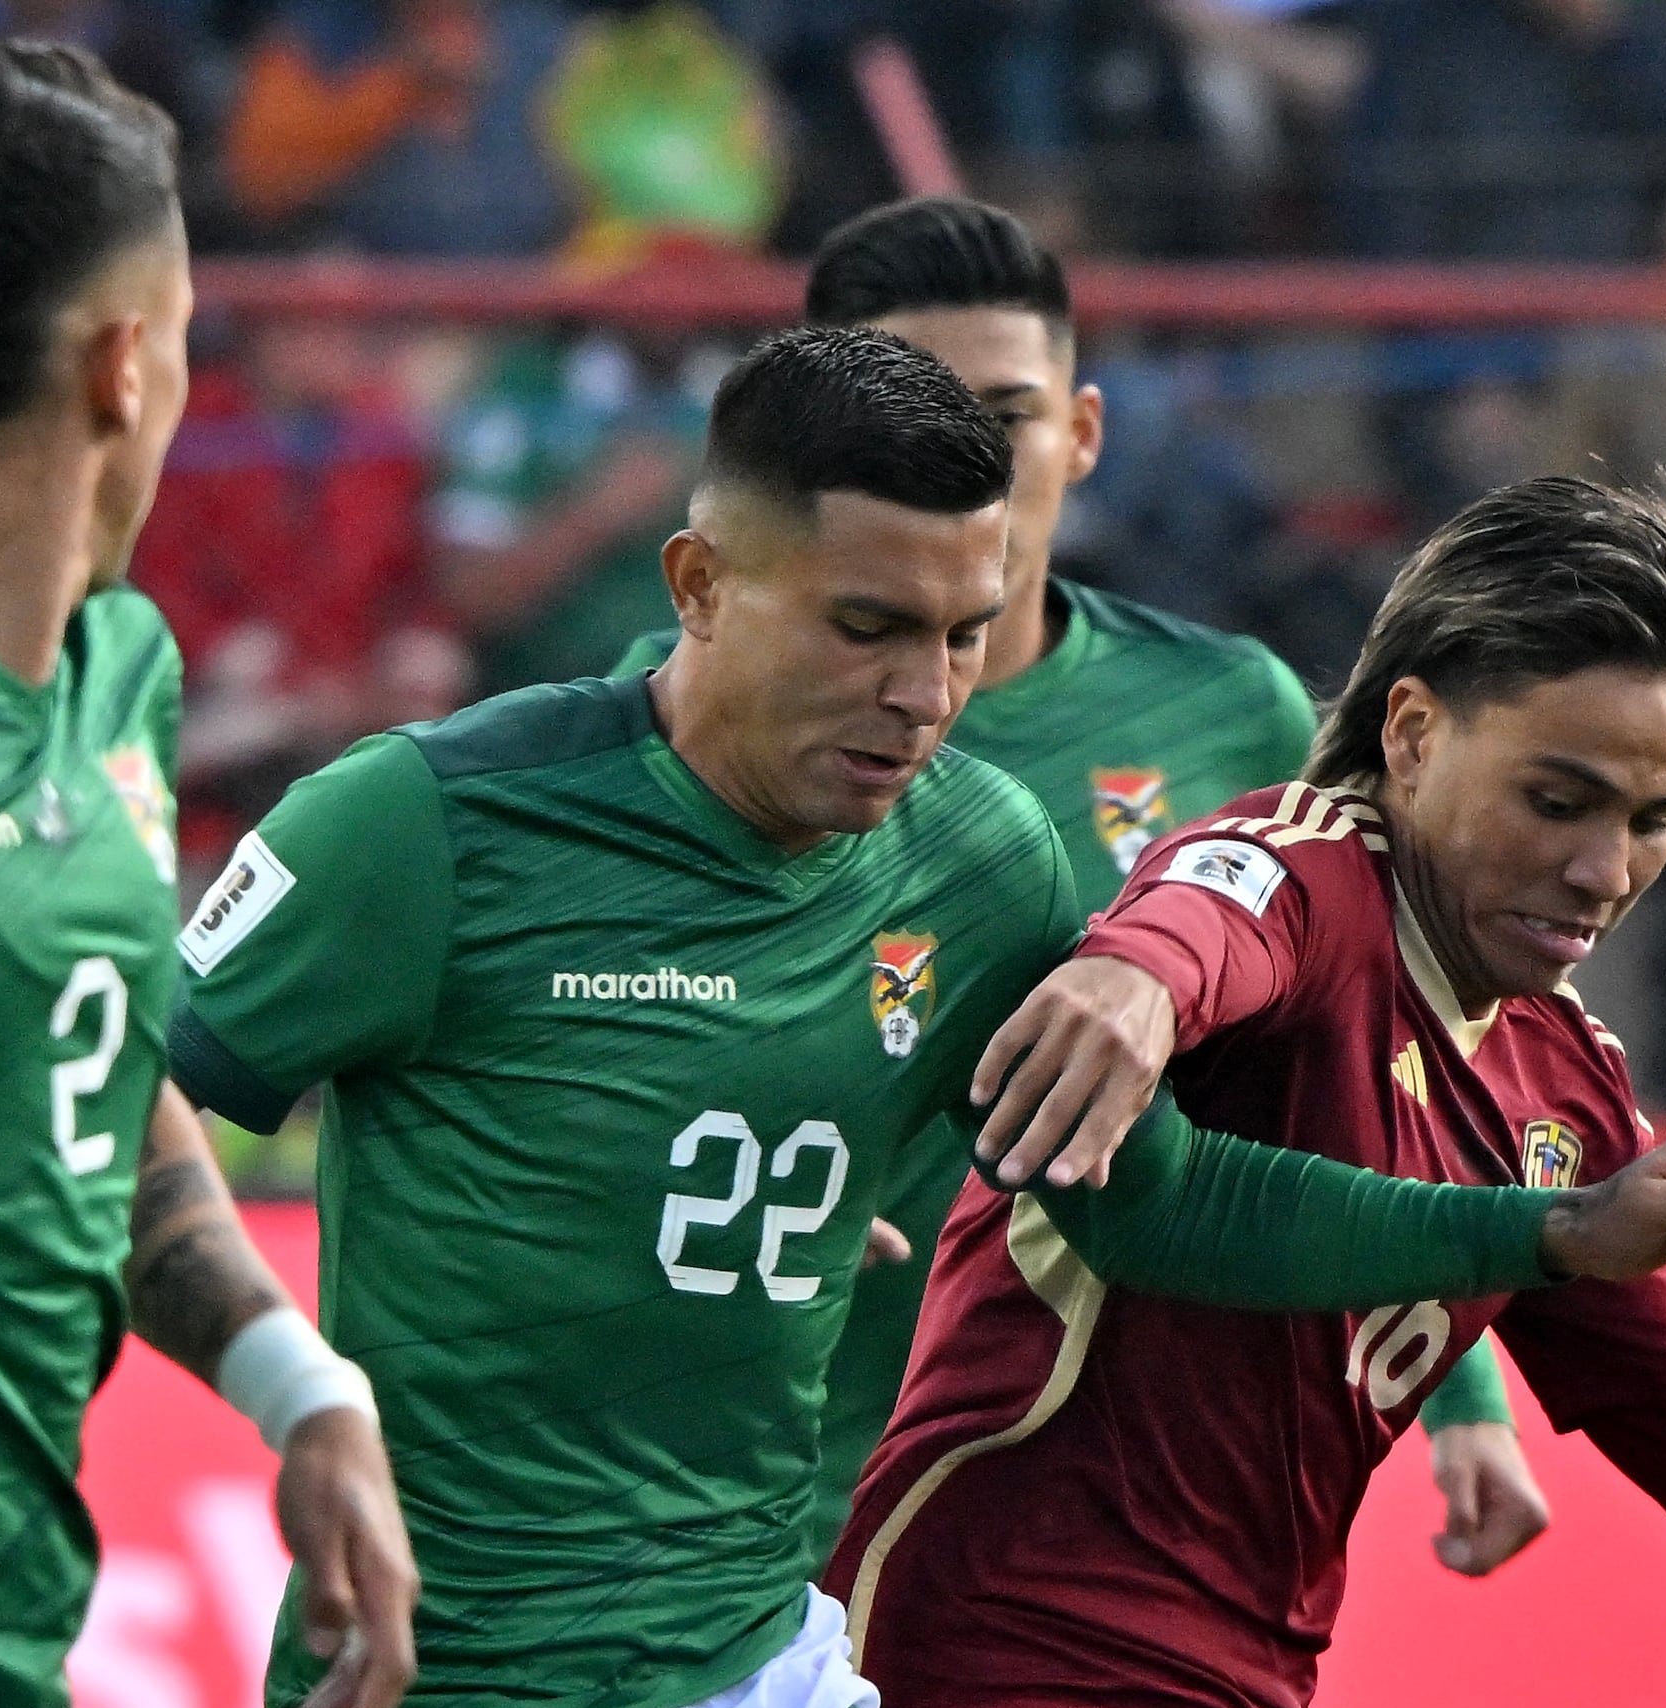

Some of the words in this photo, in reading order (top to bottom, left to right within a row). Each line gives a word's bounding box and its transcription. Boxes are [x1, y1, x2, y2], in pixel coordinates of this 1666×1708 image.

[50, 955, 129, 1177] 2
[552, 957, 737, 1001] marathon
[656, 1109, 851, 1302] 22
